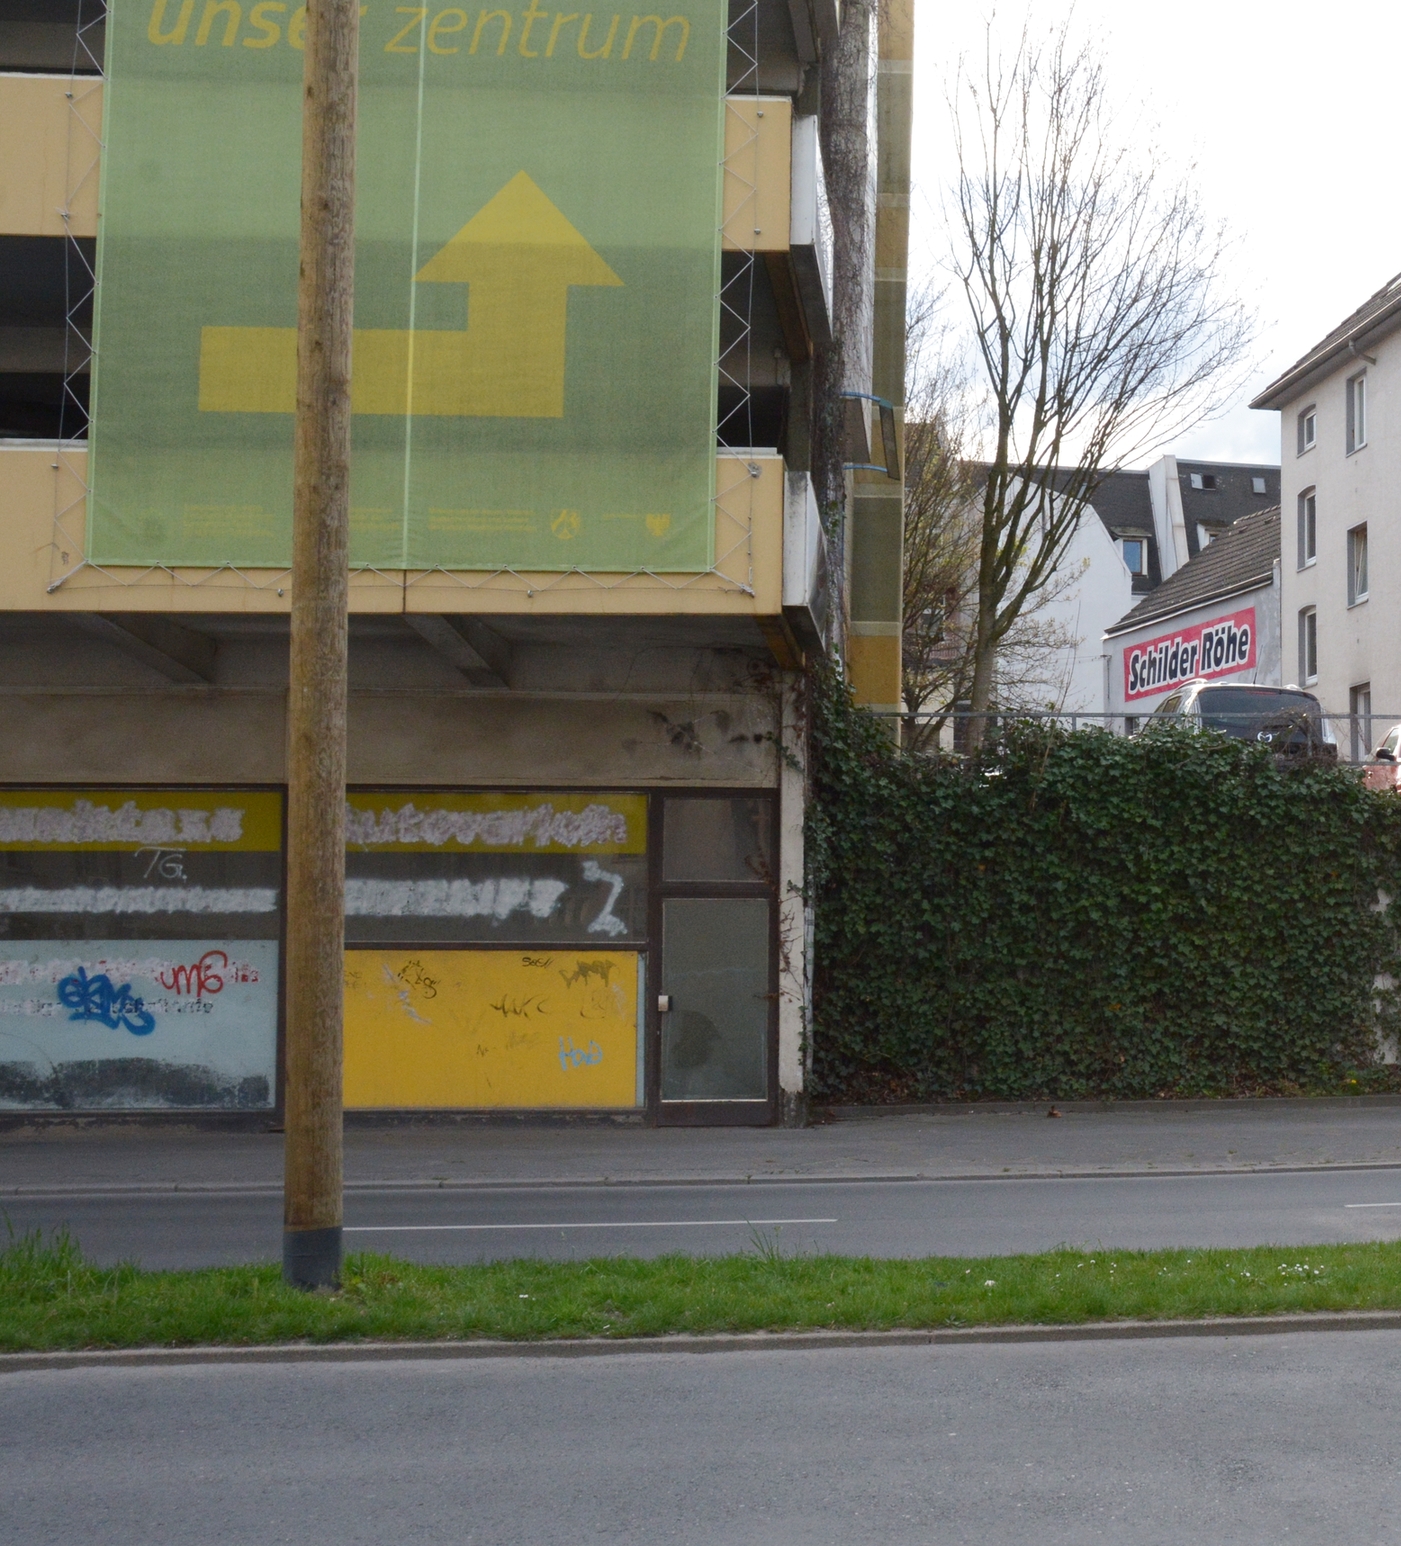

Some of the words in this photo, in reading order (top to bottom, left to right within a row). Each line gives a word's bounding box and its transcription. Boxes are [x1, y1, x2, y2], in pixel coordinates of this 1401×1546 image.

[147, 0, 368, 49] uns
[384, 0, 691, 62] zentrum
[1129, 641, 1199, 692] Schilder
[1201, 624, 1249, 671] Röhe
